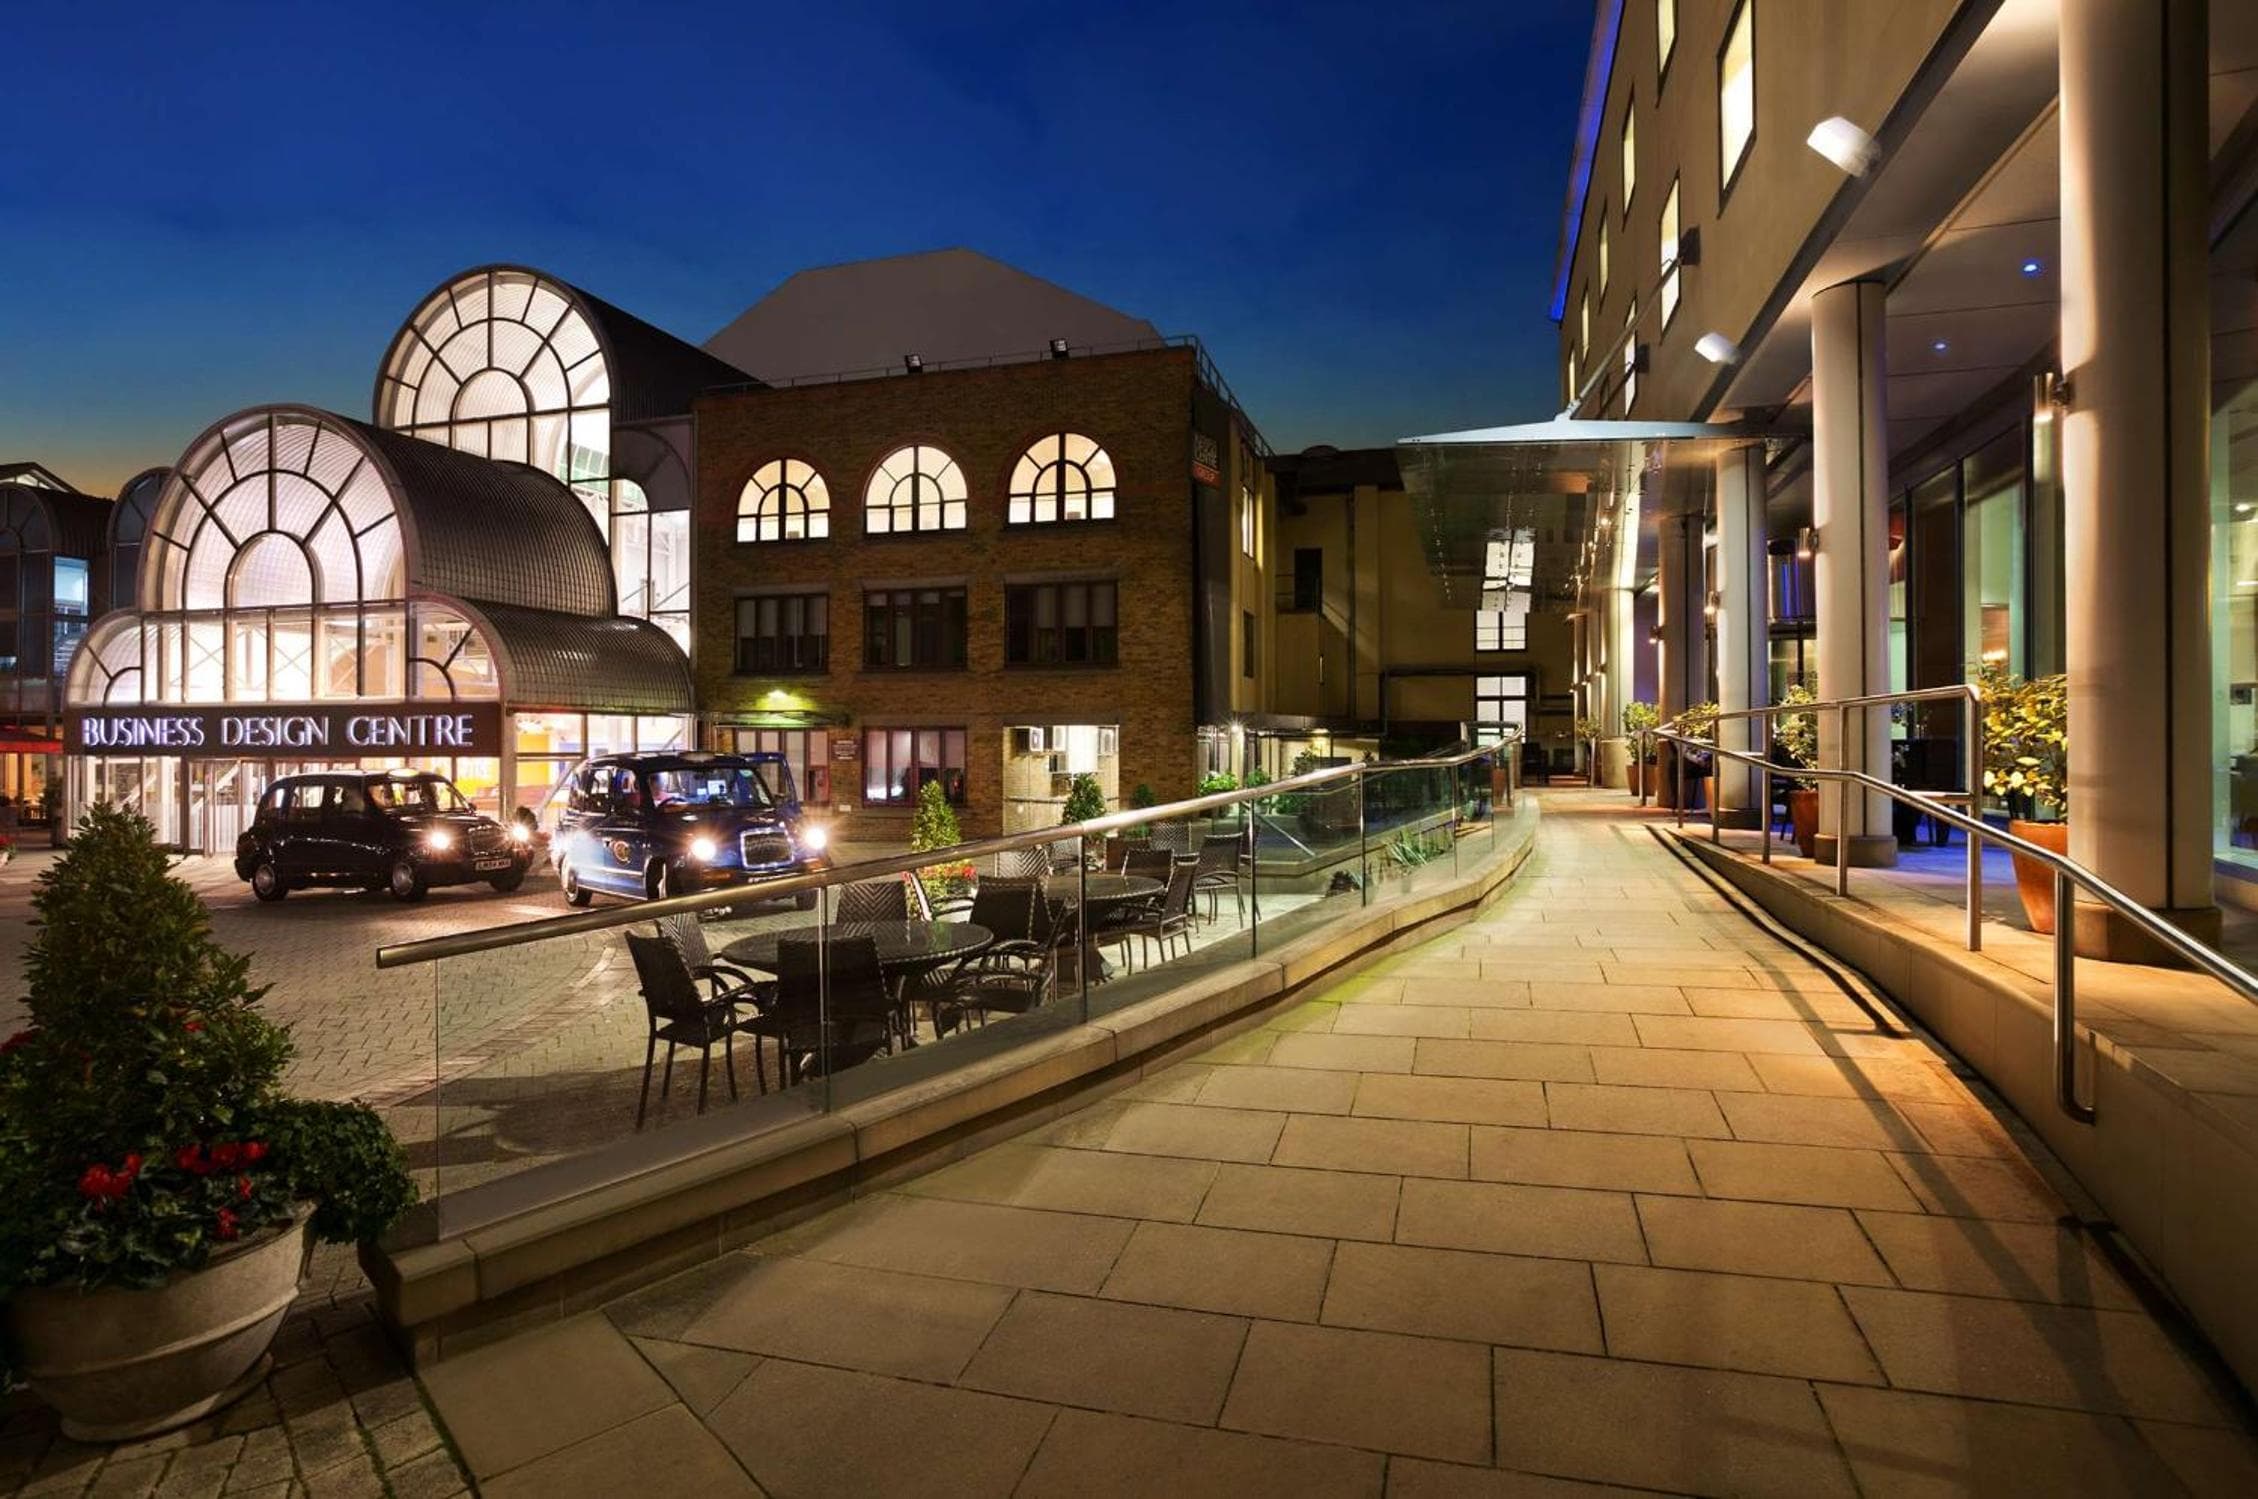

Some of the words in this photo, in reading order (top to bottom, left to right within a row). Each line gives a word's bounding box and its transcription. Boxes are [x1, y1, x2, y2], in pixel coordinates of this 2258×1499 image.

[82, 717, 206, 746] BUSINESS
[221, 716, 330, 746] DESIGN
[347, 714, 474, 746] CENTRE
